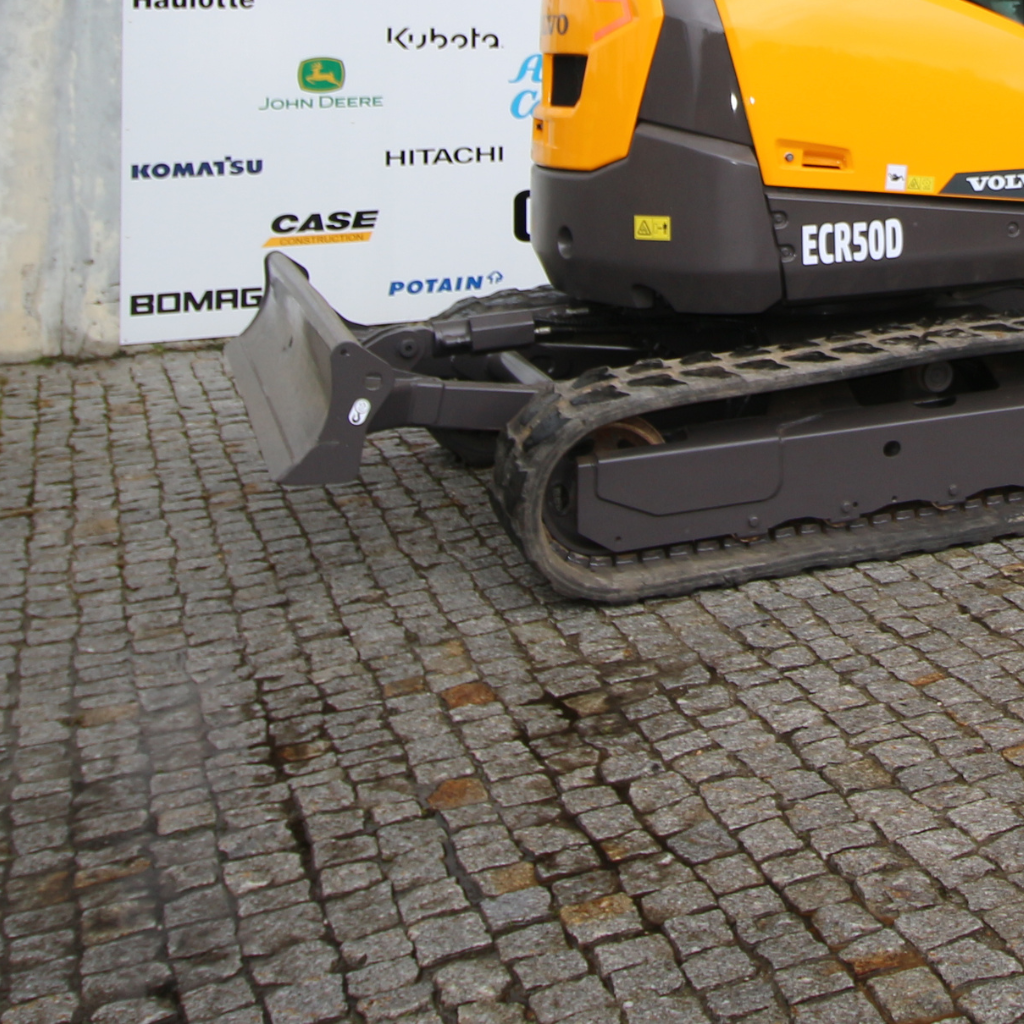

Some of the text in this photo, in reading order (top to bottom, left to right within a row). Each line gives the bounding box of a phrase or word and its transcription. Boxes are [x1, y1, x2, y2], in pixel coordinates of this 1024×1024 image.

[386, 27, 500, 50] Kubota
[258, 96, 384, 111] JOHN DEERE
[131, 156, 263, 180] KOMATSU
[385, 146, 503, 167] HITACHI
[271, 210, 379, 234] CASE
[279, 233, 365, 247] CONSTRUCTION
[801, 218, 904, 266] ECR50D
[388, 275, 483, 296] POTAIN
[130, 288, 263, 317] BOMAG
